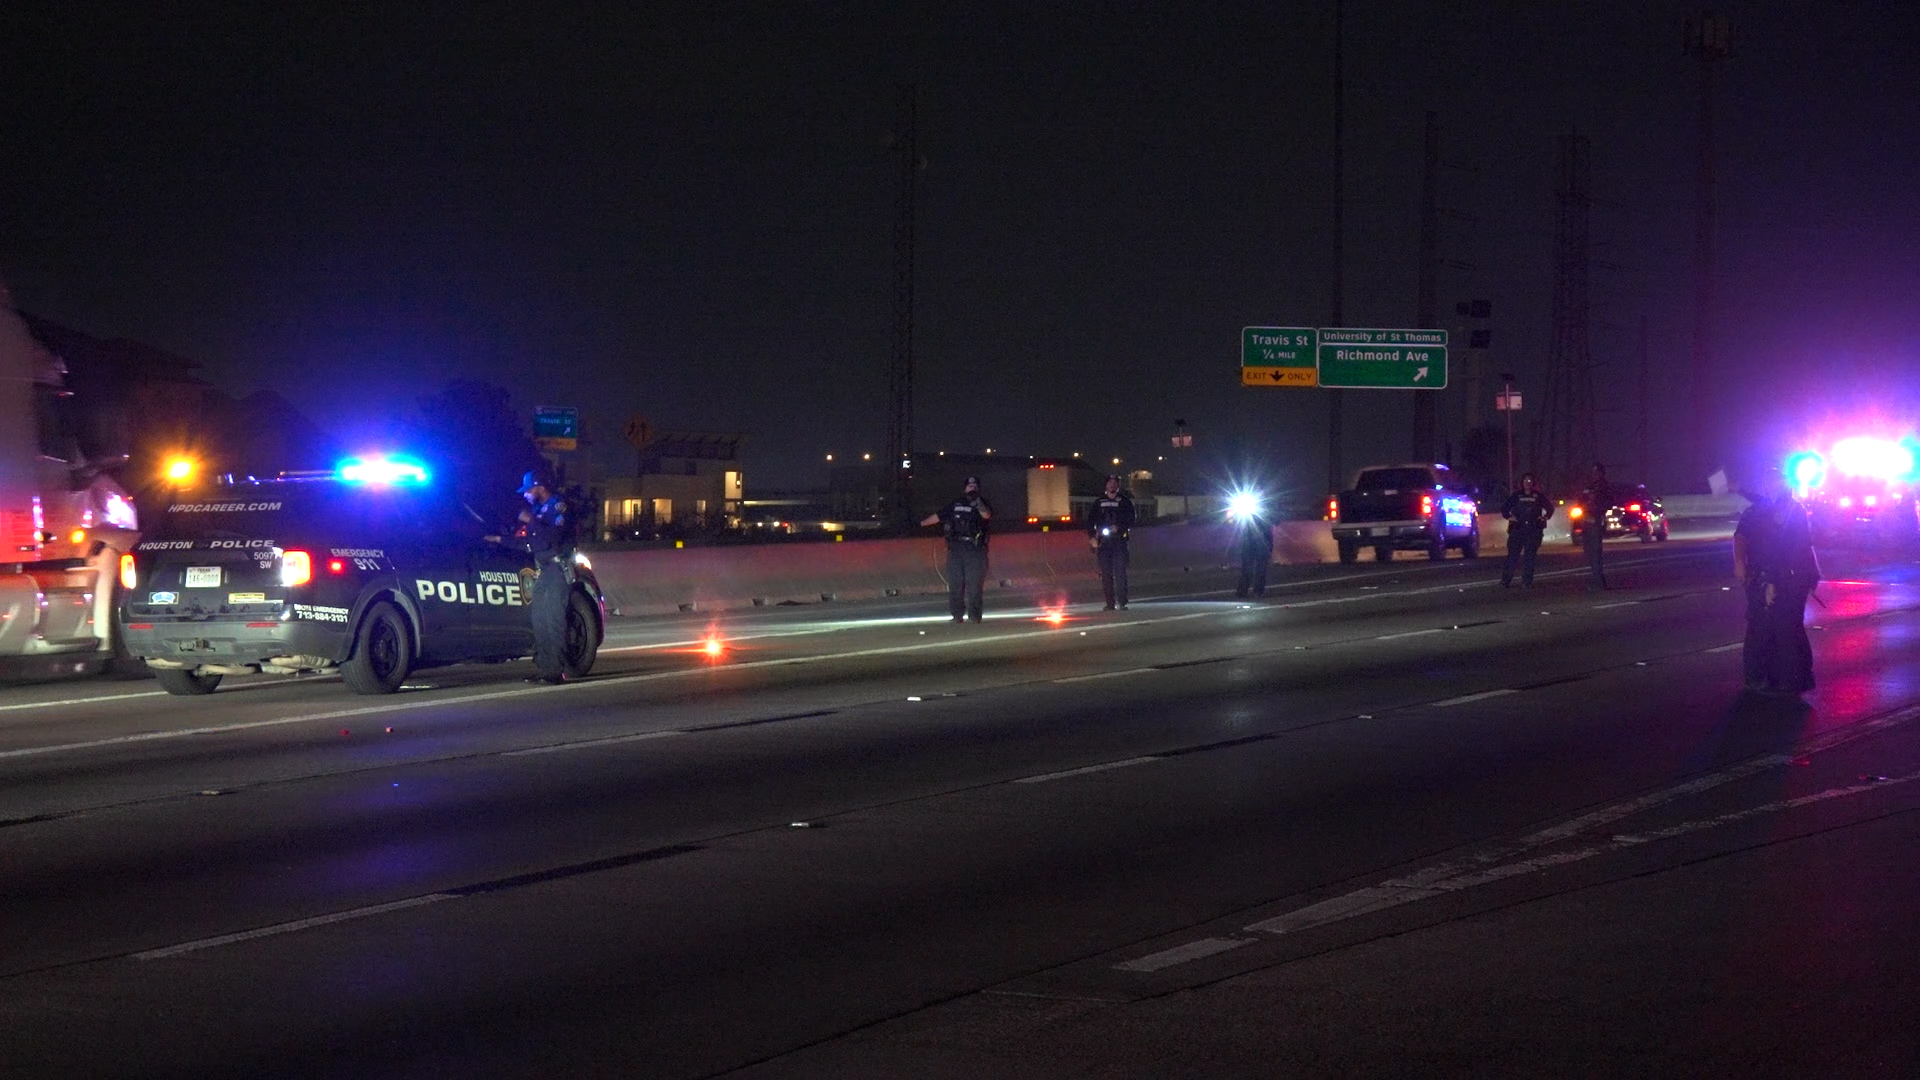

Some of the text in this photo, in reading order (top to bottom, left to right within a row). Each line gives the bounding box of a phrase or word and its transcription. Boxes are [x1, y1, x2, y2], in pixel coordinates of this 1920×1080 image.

[1252, 335, 1308, 346] Travis St
[1324, 332, 1372, 342] University
[1391, 333, 1400, 341] St
[1404, 334, 1442, 342] Thomas
[1336, 350, 1429, 361] Richmond Ave
[168, 502, 282, 513] HPDCAREER.COM
[139, 540, 275, 550] HOUSTON POLICE
[331, 548, 385, 558] EMERGENCY
[260, 561, 272, 569] SW
[354, 558, 380, 570] 911
[479, 571, 519, 583] HOUSTON
[416, 579, 522, 606] POLICE
